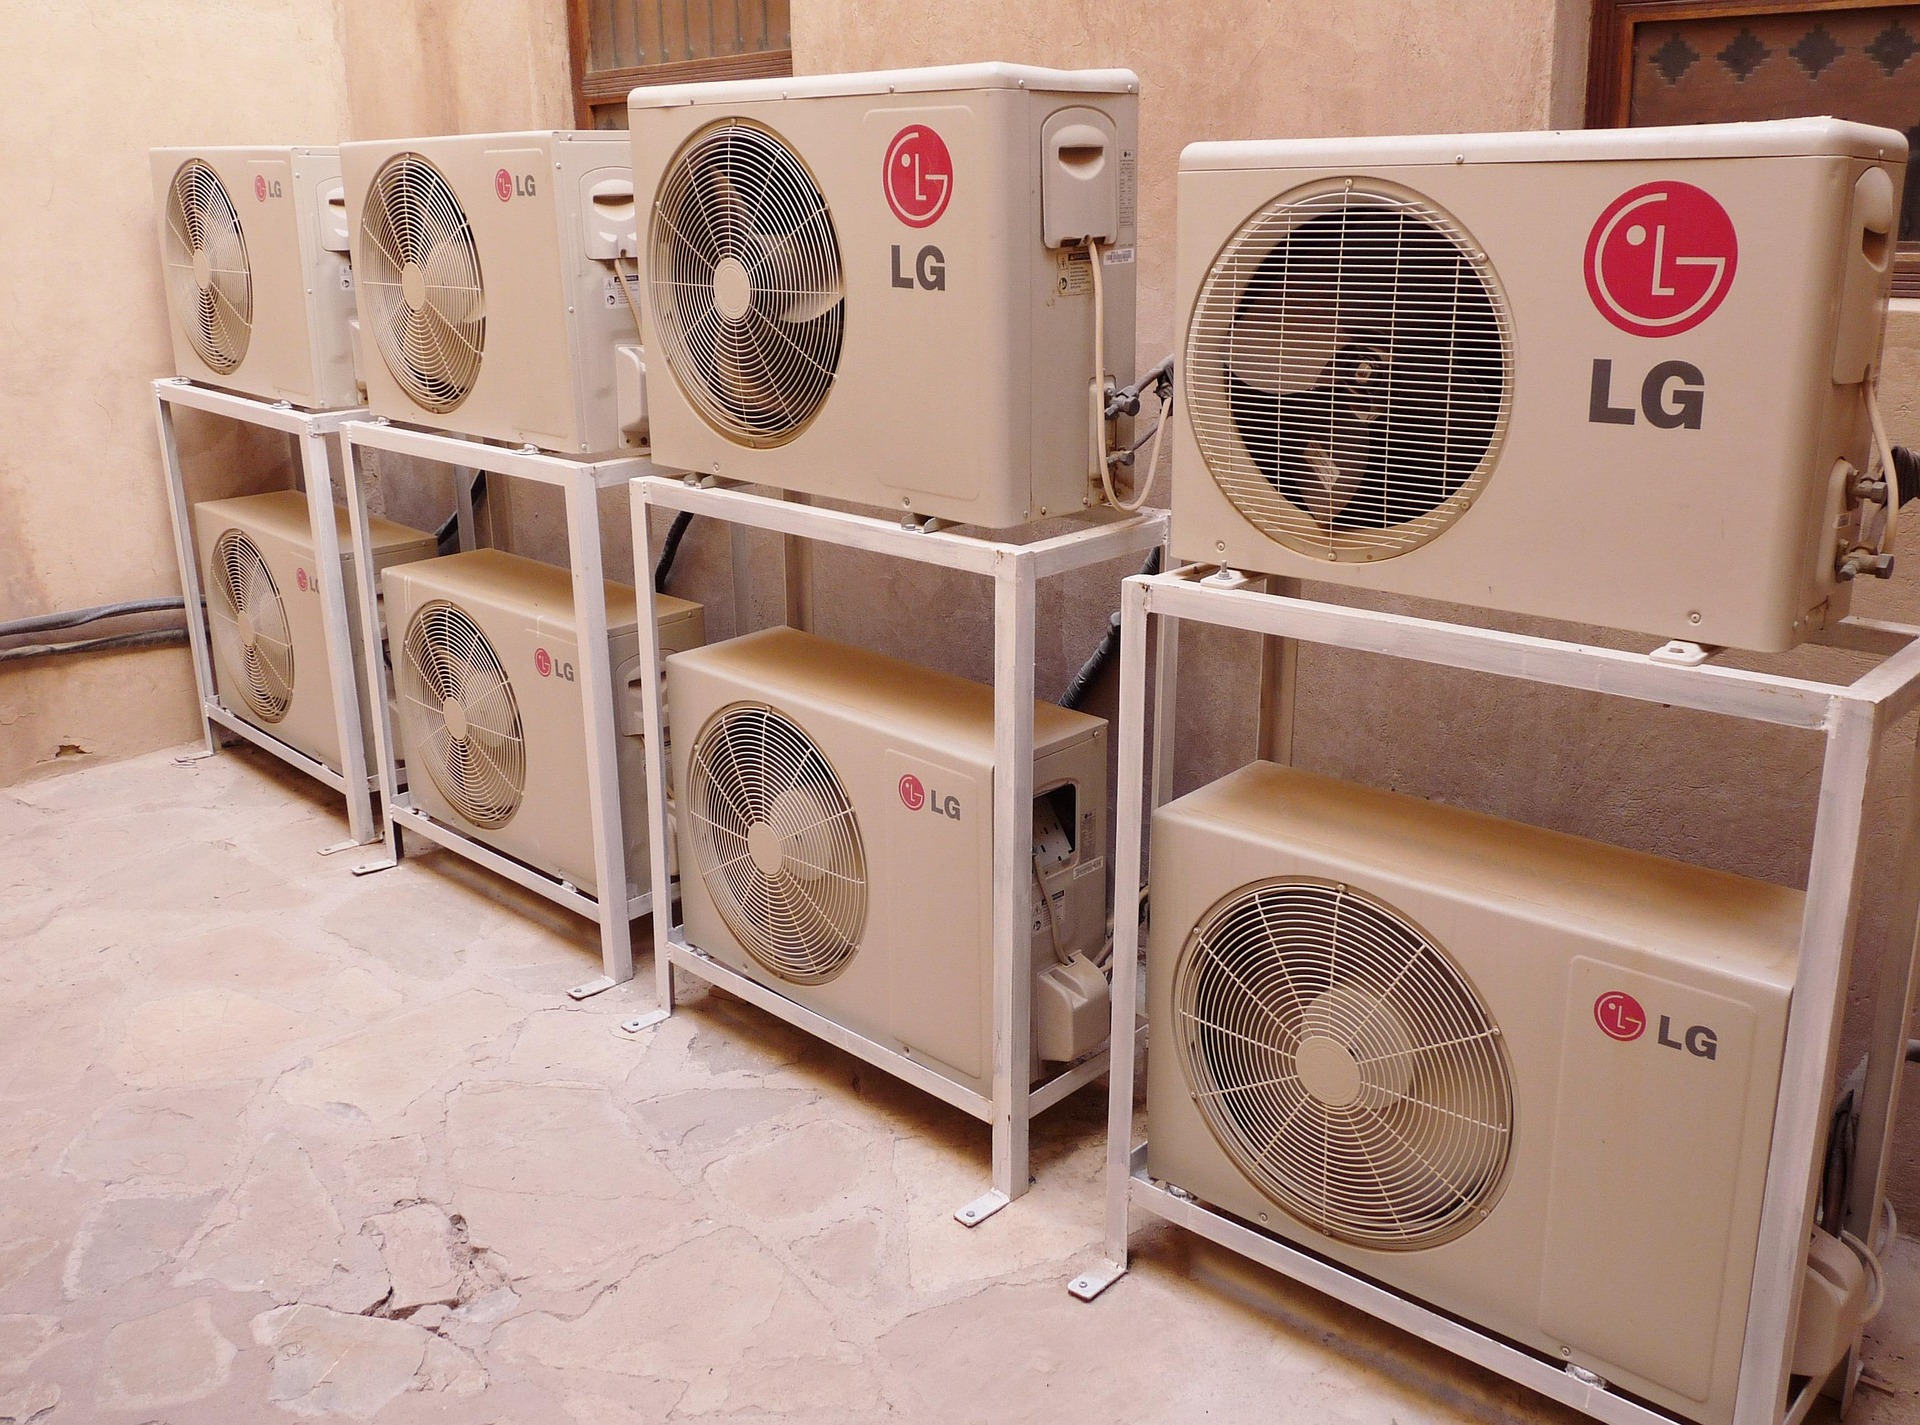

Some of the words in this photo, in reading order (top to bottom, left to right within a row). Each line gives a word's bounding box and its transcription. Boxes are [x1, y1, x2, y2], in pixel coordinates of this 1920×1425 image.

[268, 180, 282, 198] LG
[515, 175, 536, 197] LG
[891, 244, 946, 292] LG
[1588, 358, 1705, 430] LG
[554, 658, 575, 682] LG
[931, 789, 961, 821] LG
[1658, 1014, 1718, 1061] LG
